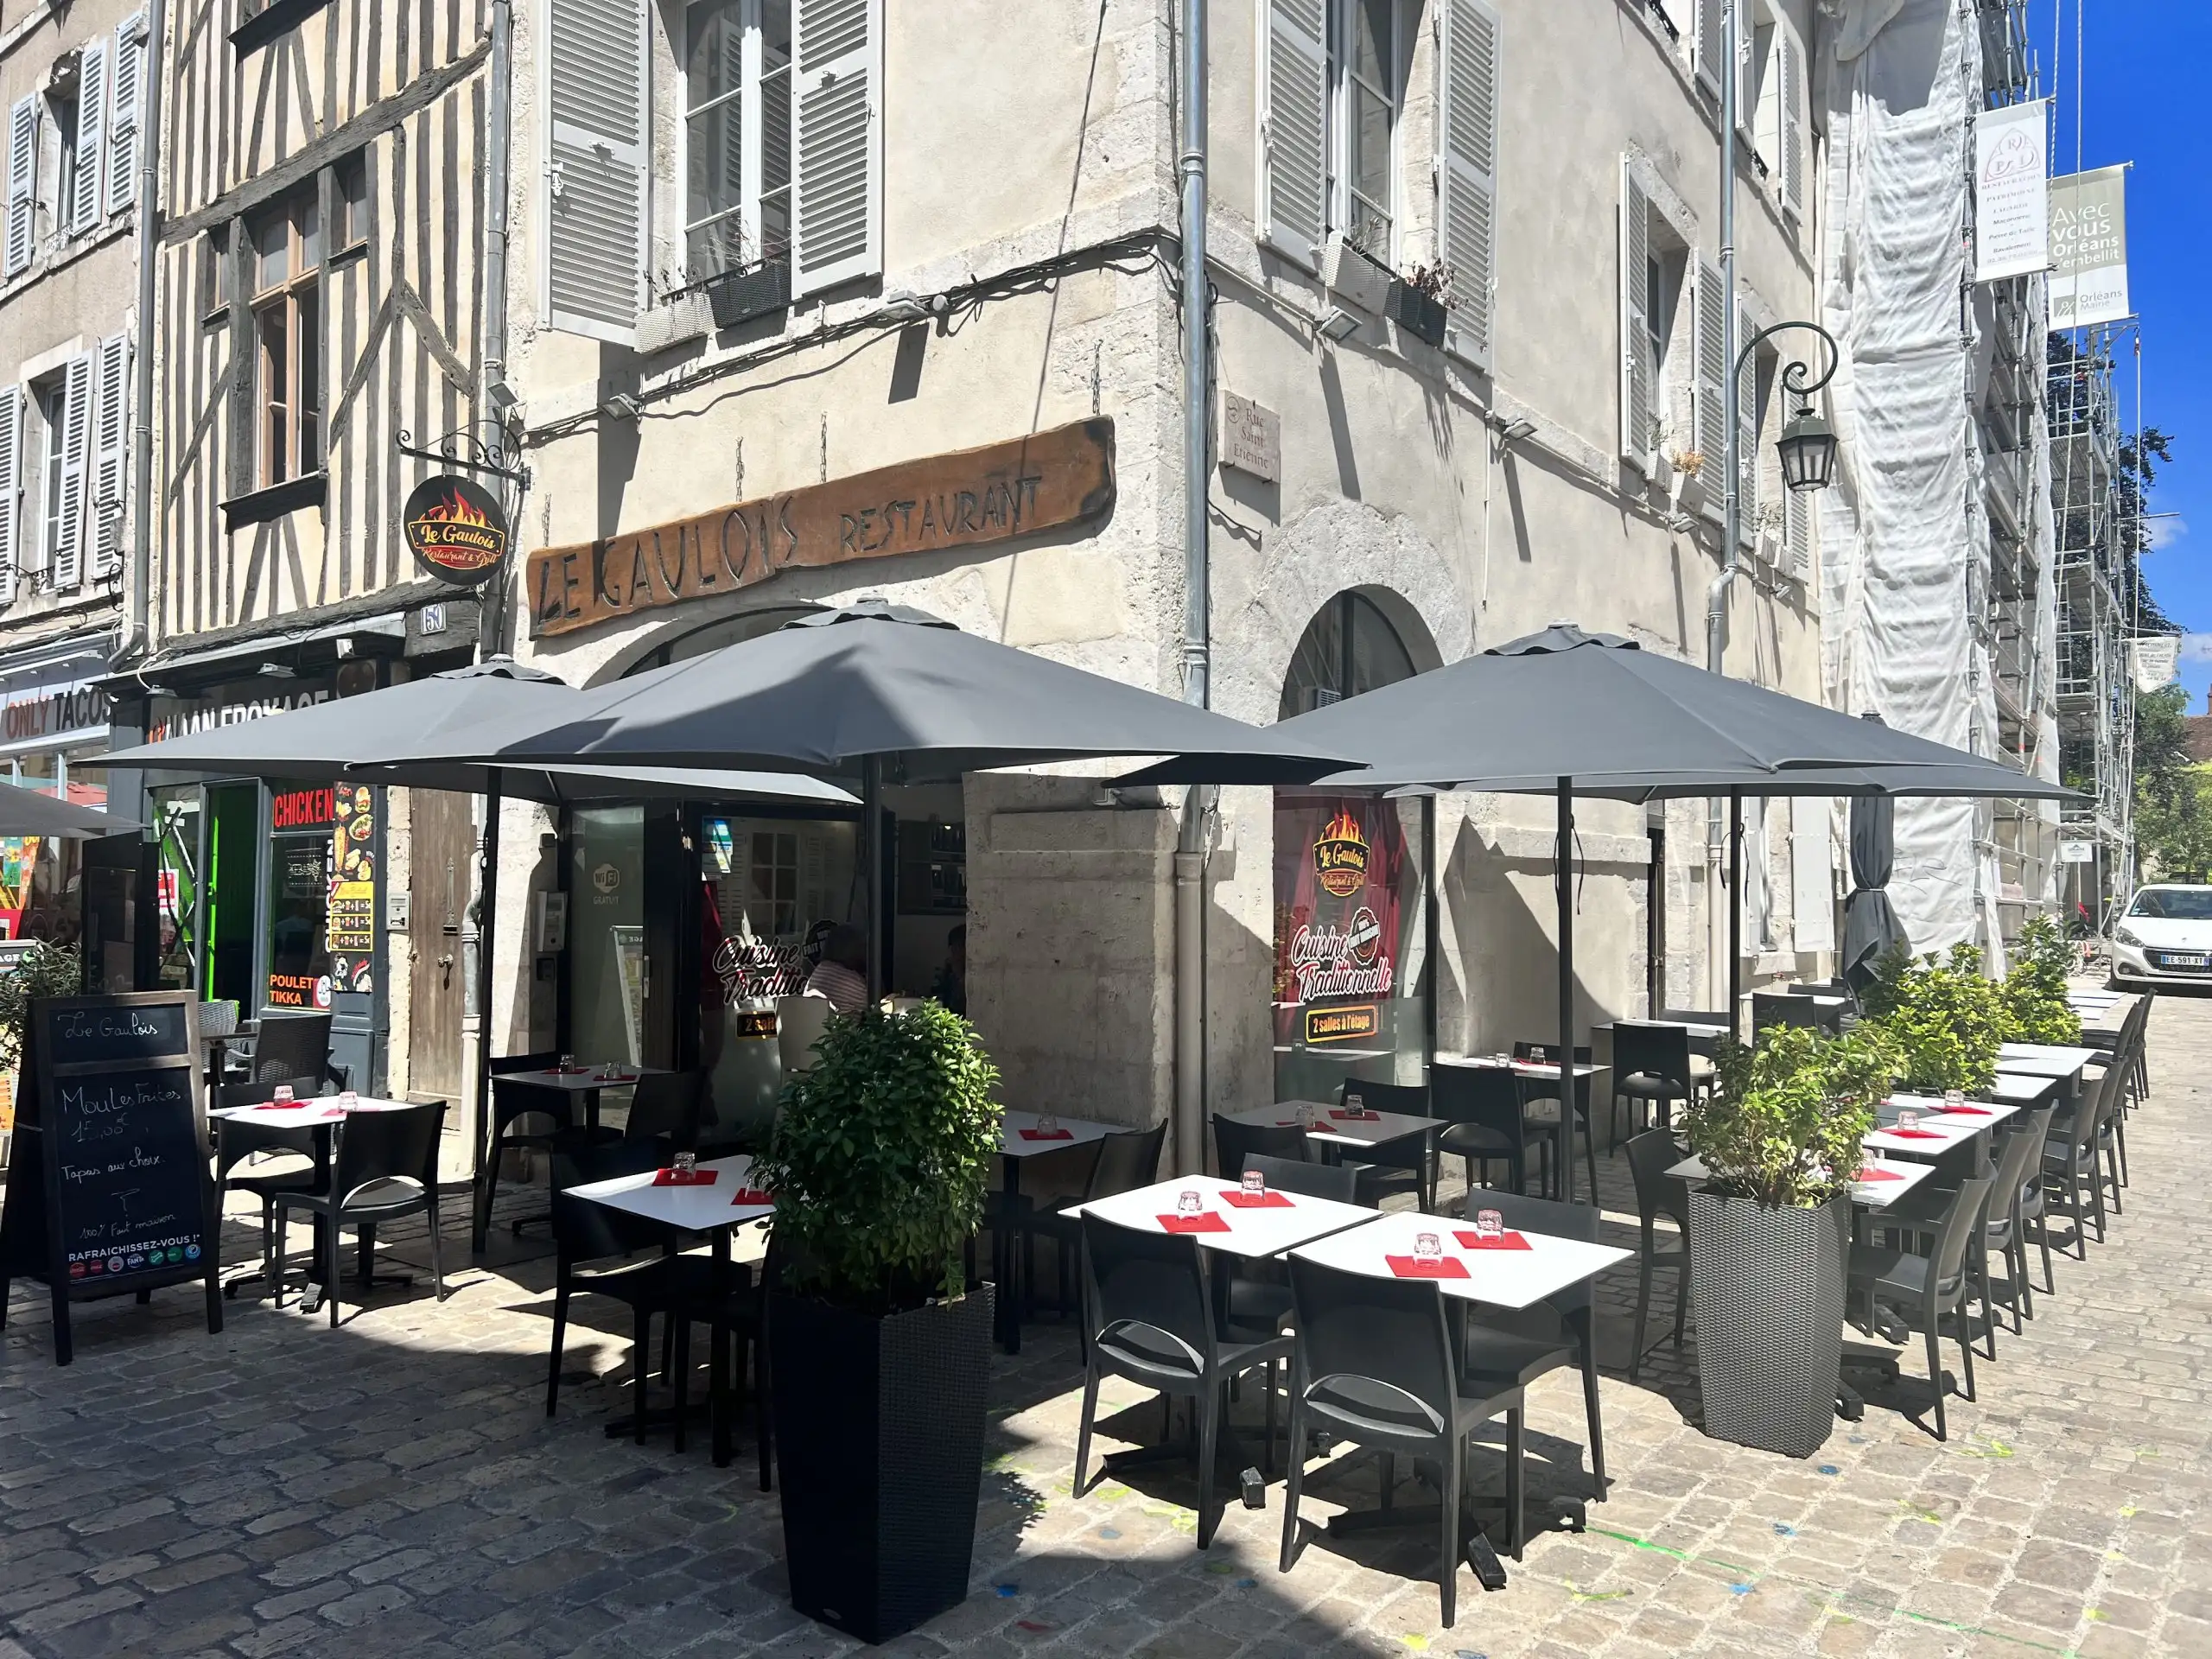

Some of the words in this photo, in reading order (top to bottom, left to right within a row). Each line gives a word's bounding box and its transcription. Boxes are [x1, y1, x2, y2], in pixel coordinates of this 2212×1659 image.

[2052, 202, 2110, 226] Avec
[2052, 219, 2111, 242] vous
[2053, 235, 2120, 257] Orléans
[2051, 250, 2120, 269] 'embellit
[2080, 289, 2123, 302] Orléans
[1245, 408, 1265, 428] Rue
[1241, 426, 1264, 448] Saint
[1234, 442, 1268, 469] Etienne
[421, 524, 442, 543] Le
[442, 524, 496, 550] Gaulois
[421, 547, 467, 563] Restaurant
[475, 551, 498, 568] Grill
[537, 553, 581, 625] LE
[600, 494, 798, 608] GAULOIS
[839, 475, 1042, 556] RESTAURANT
[7, 695, 50, 740] ONLY
[54, 685, 111, 731] TACOS
[274, 788, 334, 828] CHICKEN
[1320, 845, 1332, 868] Le
[1332, 843, 1364, 868] Gaulois
[593, 895, 620, 906] GRATUIT
[712, 936, 800, 974] Cuisine
[1291, 925, 1348, 967] Cuisine
[270, 975, 314, 989] POULET
[720, 967, 810, 1006] Traditio
[1296, 957, 1392, 1001] Traditionnelle
[270, 989, 302, 1005] TIKKA
[57, 1011, 92, 1039] Le
[99, 1012, 158, 1037] Gaulois
[746, 1018, 753, 1032] 2
[754, 1016, 776, 1031] sall
[1313, 1018, 1319, 1033] 2
[1319, 1016, 1340, 1033] salles
[1341, 1014, 1346, 1030] à
[1347, 1014, 1370, 1030] l'étage
[61, 1165, 101, 1184] Tapas
[108, 1162, 125, 1173] aux
[68, 1235, 190, 1262] RAFRAICHISSEZ-VOUS
